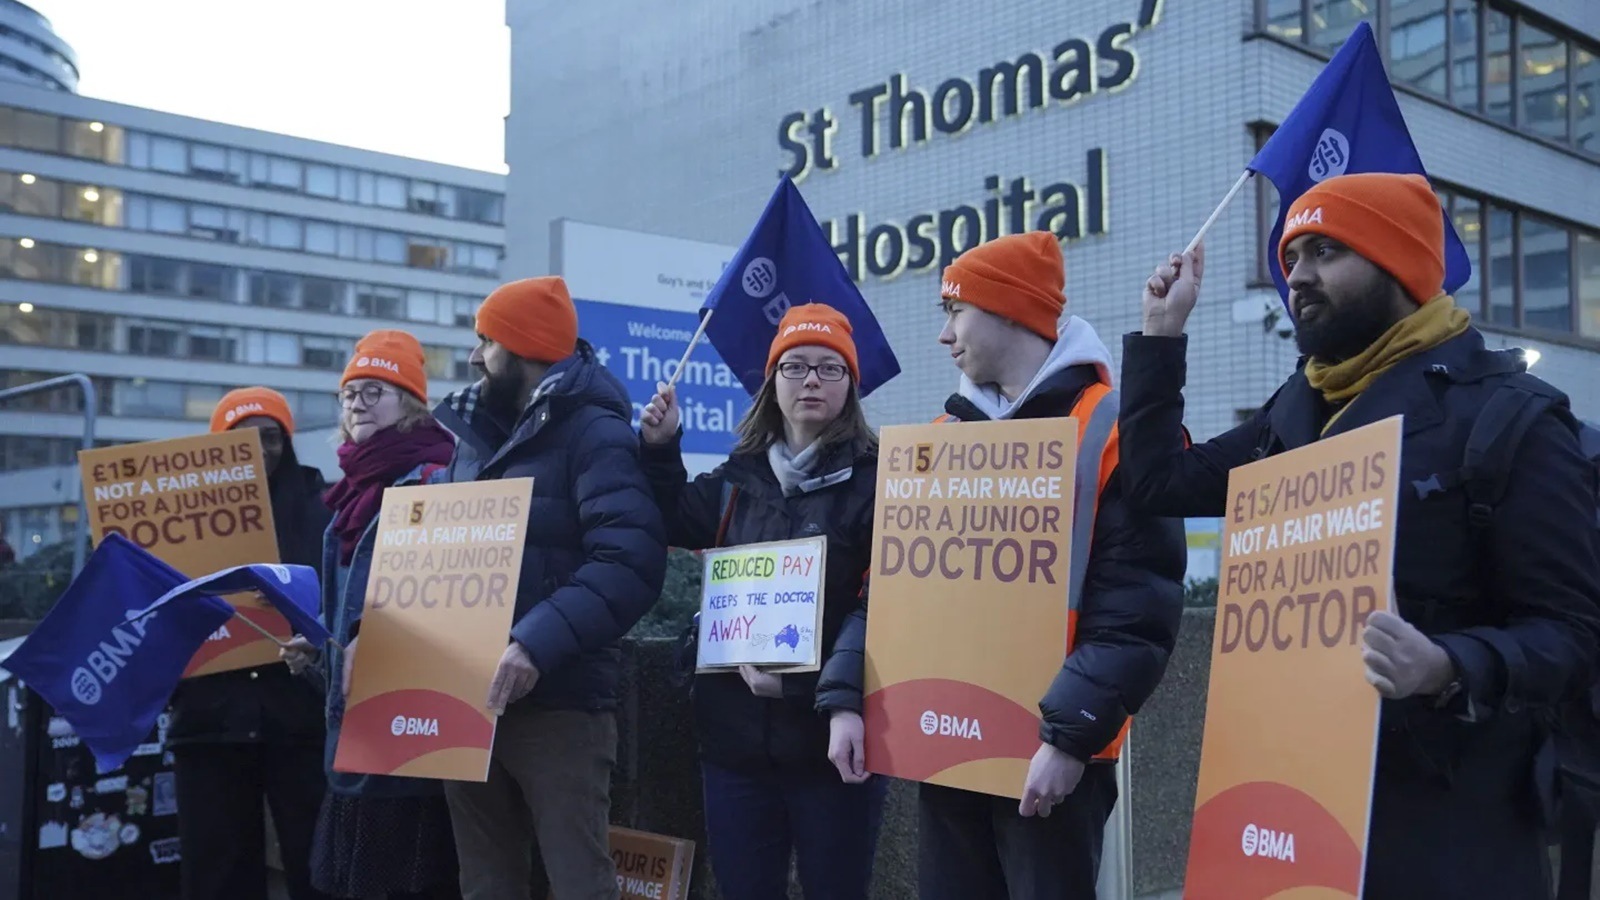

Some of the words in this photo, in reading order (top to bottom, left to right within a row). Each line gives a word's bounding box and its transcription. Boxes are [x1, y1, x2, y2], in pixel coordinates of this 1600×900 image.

[778, 108, 836, 182] St
[820, 146, 1105, 281] Hospital
[627, 321, 692, 343] Welcome
[796, 322, 832, 334] BMA
[371, 357, 399, 373] BMA
[235, 402, 263, 414] BMA
[630, 397, 734, 432] oital
[92, 446, 225, 482] £15/HOUR
[231, 443, 252, 462] IS
[887, 441, 1029, 473] £15/HOUR
[1037, 440, 1064, 470] IS
[93, 482, 135, 502] NOT
[139, 480, 154, 496] A
[157, 473, 200, 492] FAIR
[202, 465, 256, 486] WAGE
[885, 477, 925, 499] NOT
[928, 478, 943, 499] A
[948, 476, 993, 499] FAIR
[999, 476, 1062, 499] WAGE
[1233, 461, 1355, 524] £15/HOUR
[1362, 451, 1386, 492] IS
[97, 500, 148, 523] FOR
[154, 498, 170, 515] A
[174, 483, 260, 515] JUNIOR
[388, 497, 496, 525] £15/HOUR
[501, 496, 521, 519] IS
[382, 528, 417, 546] NOT
[417, 527, 429, 545] A
[431, 526, 468, 544] FAIR
[470, 523, 518, 542] WAGE
[883, 505, 931, 531] FOR
[935, 505, 954, 531] A
[957, 505, 1061, 537] JUNIOR
[1229, 526, 1264, 557] NOT
[1266, 523, 1279, 550] A
[1282, 512, 1322, 547] FAIR
[1326, 498, 1384, 537] WAGE
[378, 551, 418, 572] FOR
[421, 549, 434, 570] A
[437, 547, 514, 573] JUNIOR
[711, 556, 775, 581] REDUCED
[782, 555, 814, 576] PAY
[879, 535, 1058, 585] DOCTOR
[1226, 560, 1268, 596] FOR
[1271, 557, 1286, 590] A
[1290, 539, 1380, 593] JUNIOR
[371, 572, 509, 610] DOCTOR
[709, 593, 738, 610] KEEPS
[746, 592, 768, 606] THE
[774, 591, 815, 604] DOCTOR
[708, 615, 757, 643] AWAY
[1220, 585, 1377, 654] DOCTOR
[87, 609, 158, 685] BMA
[406, 717, 439, 736] BMA
[939, 714, 982, 741] BMA
[1257, 828, 1295, 863] BMA
[651, 857, 667, 879] IS
[626, 877, 664, 900] WAGE
